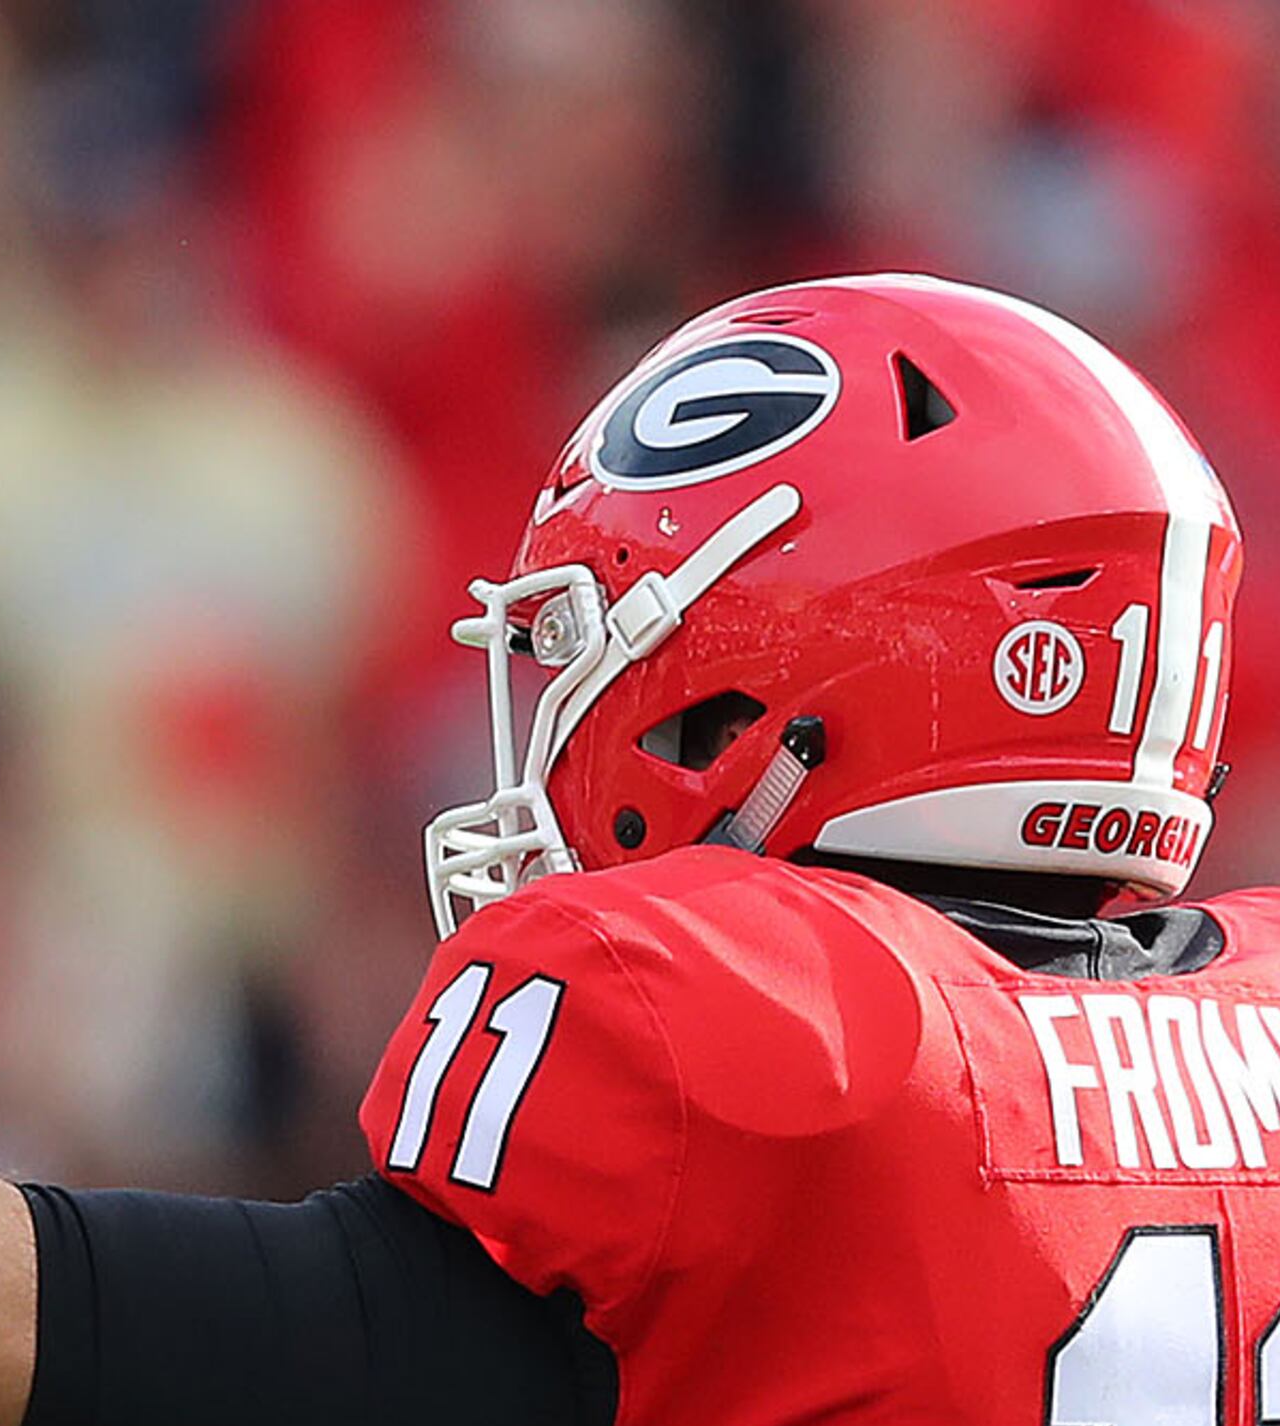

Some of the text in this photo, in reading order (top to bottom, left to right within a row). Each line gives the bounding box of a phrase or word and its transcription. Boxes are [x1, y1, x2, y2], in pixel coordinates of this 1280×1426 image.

[630, 354, 842, 452] G
[1004, 630, 1074, 703] SEC
[1020, 801, 1201, 870] GEORGIA
[387, 960, 568, 1193] 11
